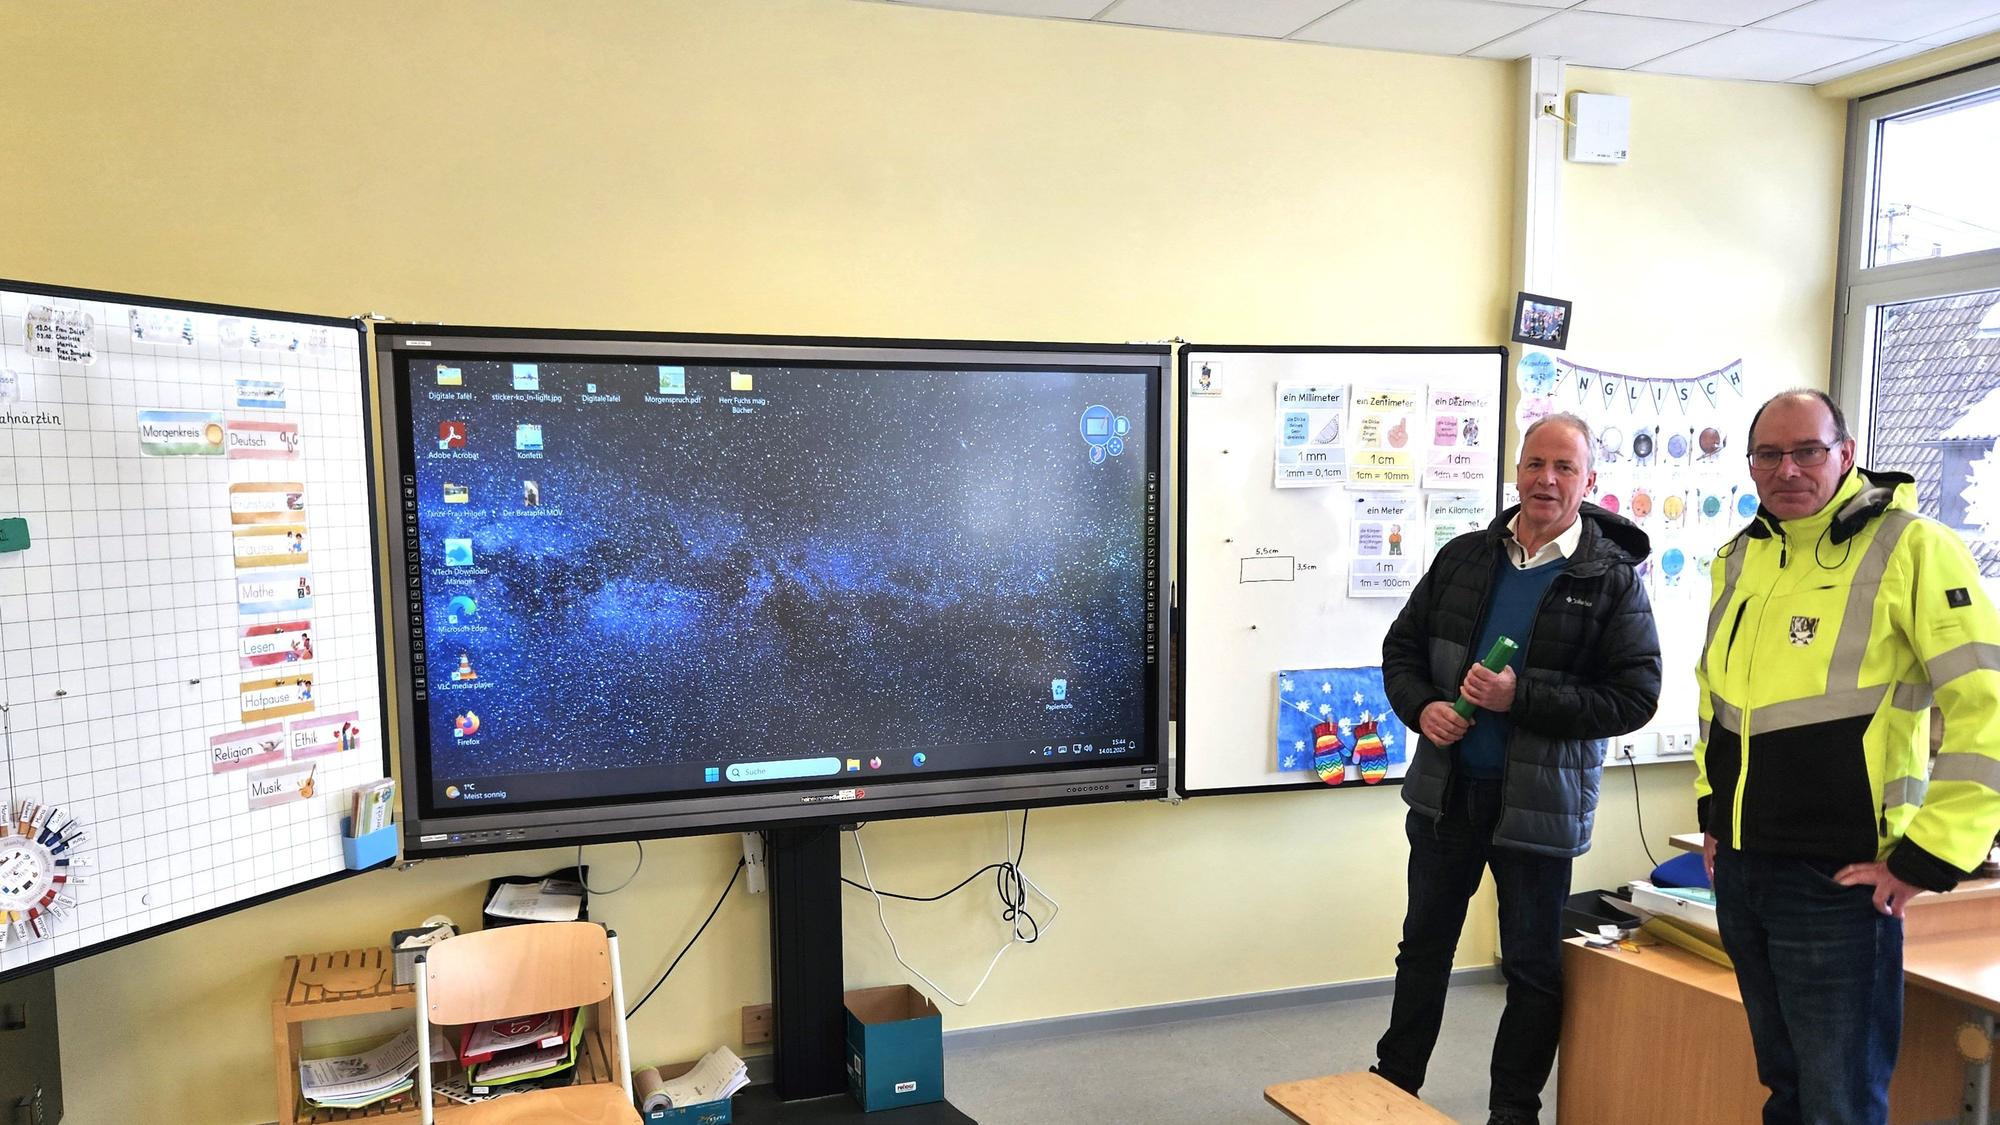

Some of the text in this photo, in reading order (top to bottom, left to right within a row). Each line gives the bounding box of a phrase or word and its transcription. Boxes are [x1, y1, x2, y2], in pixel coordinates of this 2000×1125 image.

[428, 392, 472, 401] Digitale Tafel
[581, 395, 621, 403] DigitaleTafel
[644, 395, 701, 404] Morgenspruch.pdf
[1298, 394, 1340, 402] Millimeter
[1370, 397, 1414, 407] Zentimeter
[1449, 398, 1489, 407] Dezimeter
[732, 406, 753, 414] Bücher
[142, 426, 200, 443] Morgenkreis
[230, 432, 267, 446] Deutsch
[428, 451, 479, 460] Adobe Acrobat
[1298, 452, 1327, 461] 1 mm
[1371, 454, 1395, 464] 1 cm
[1447, 454, 1471, 464] 1 dm
[1315, 469, 1342, 478] 0,1cm
[1356, 471, 1373, 479] 1cm
[1384, 472, 1410, 480] 10mm
[1434, 471, 1451, 479] 1dm
[1463, 471, 1484, 479] 10cm
[503, 509, 514, 517] Der
[1367, 507, 1404, 515] ein Meter
[1448, 506, 1485, 514] Kilometer
[1297, 563, 1317, 571] 3,5cm
[1376, 562, 1394, 572] 1 m
[432, 568, 488, 576] VTech Download
[445, 578, 476, 586] Manager
[1360, 579, 1372, 587] 1m
[1384, 579, 1411, 587] 100cm
[241, 583, 274, 598] Mathe
[438, 624, 489, 633] Microsoft Edge
[243, 640, 275, 656] Lesen
[437, 682, 451, 690] VLC
[474, 681, 494, 690] player
[244, 692, 290, 710] Hofpause
[1045, 703, 1074, 711] Papierkorb
[295, 732, 318, 748] Ethik
[457, 737, 480, 746] Firefox
[214, 744, 253, 764] Religion
[1099, 746, 1126, 755] 14.01.2025
[745, 767, 767, 776] Suche
[251, 780, 282, 797] Musik
[464, 791, 507, 800] Meist sonnig
